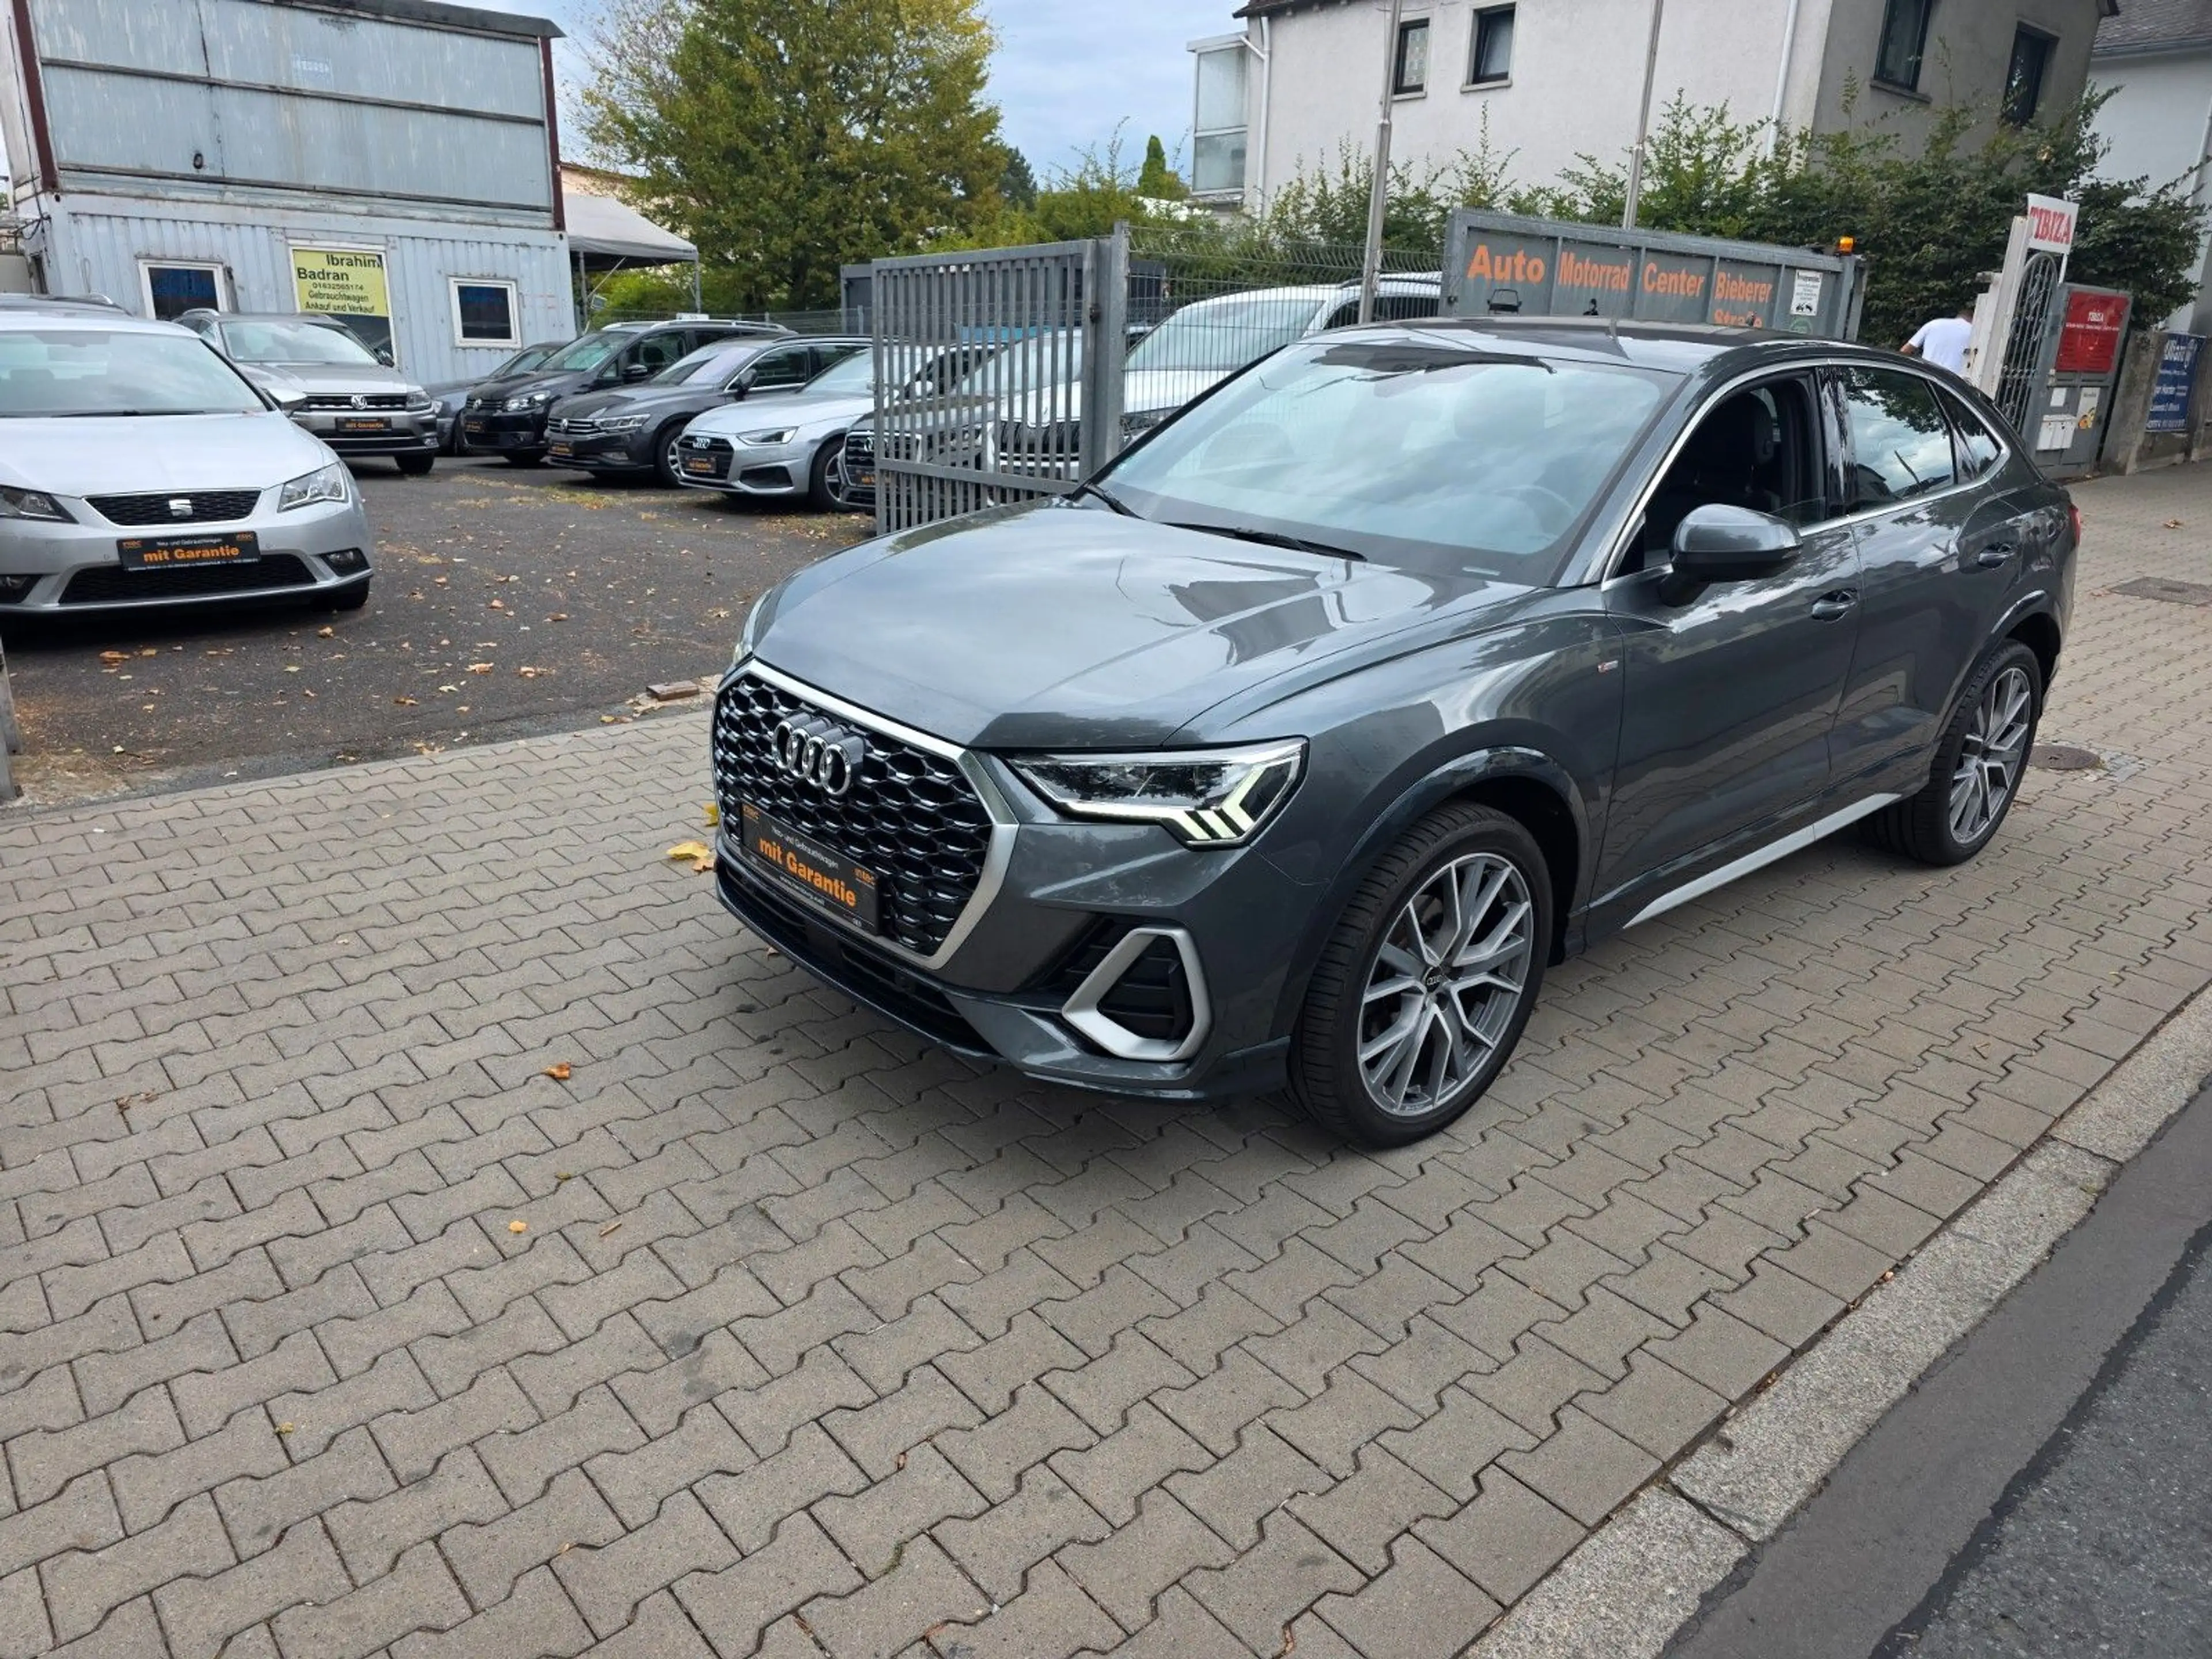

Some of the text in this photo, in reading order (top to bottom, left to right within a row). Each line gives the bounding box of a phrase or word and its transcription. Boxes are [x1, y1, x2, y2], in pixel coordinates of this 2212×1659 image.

[326, 254, 381, 268] Ibrahim
[297, 267, 350, 281] Badran
[1467, 244, 1547, 283] Auto
[1558, 251, 1632, 291] Motorrad
[1643, 263, 1706, 297] Center
[1714, 271, 1772, 302] Bieberer
[308, 290, 369, 303] Gebrauchtwagen
[305, 302, 374, 313] Ankauf und Verkauf
[144, 544, 240, 563] mit Garantie
[759, 838, 782, 865] mit
[786, 851, 857, 907] Garantie
